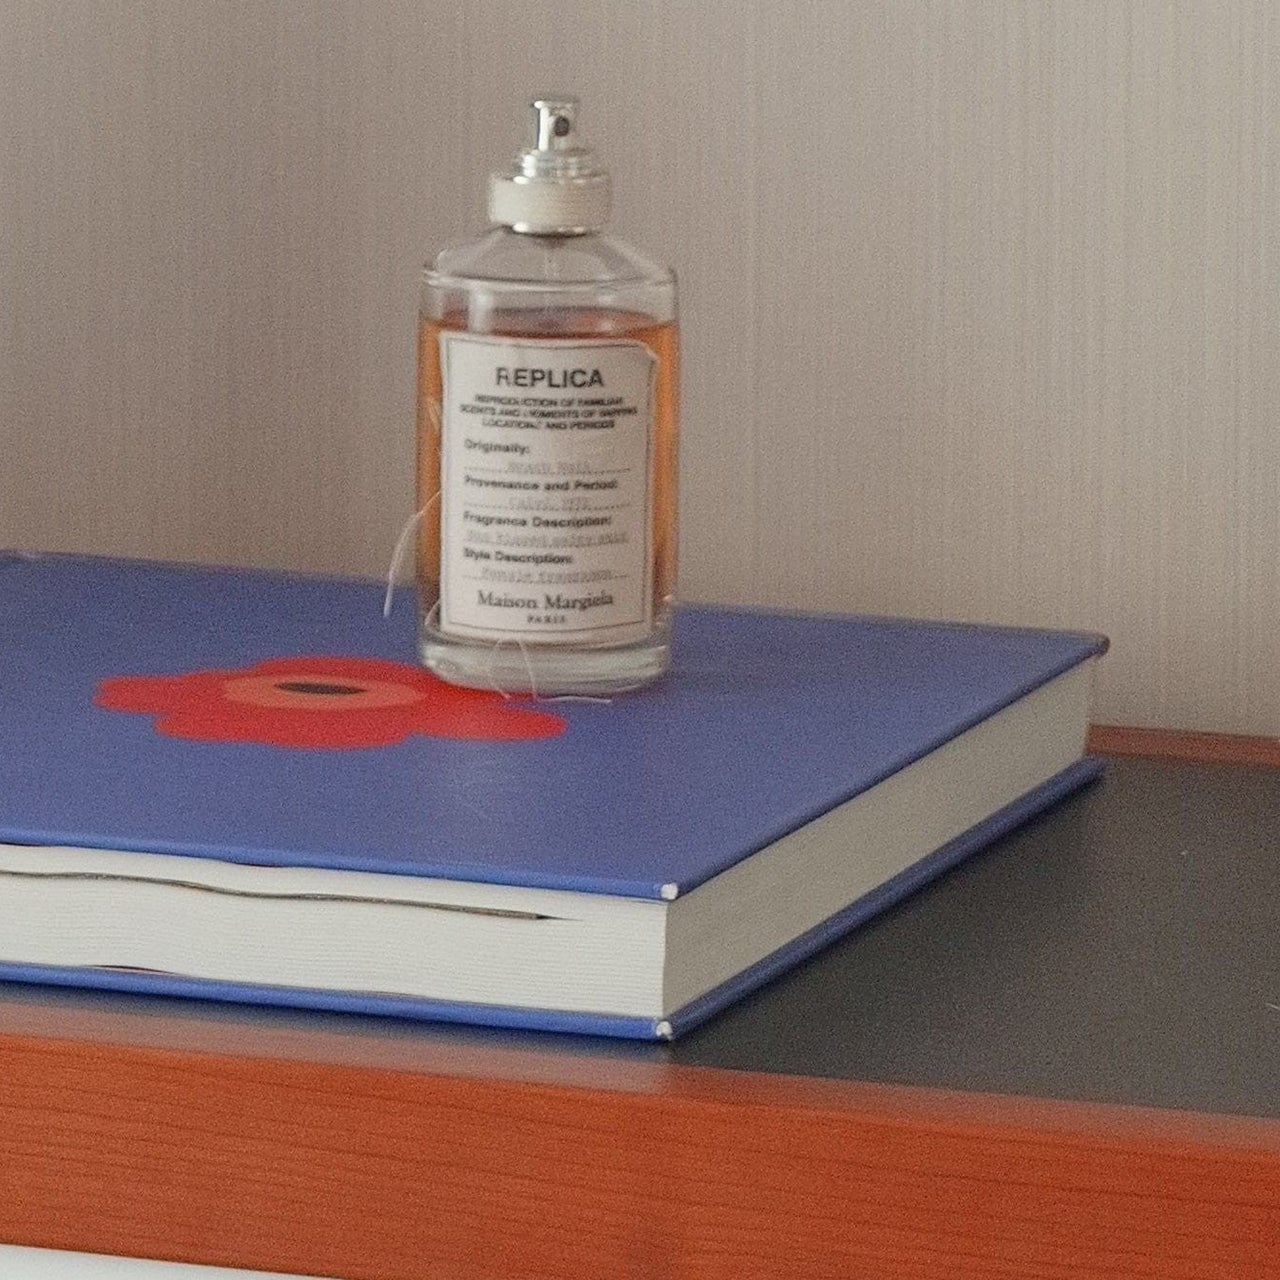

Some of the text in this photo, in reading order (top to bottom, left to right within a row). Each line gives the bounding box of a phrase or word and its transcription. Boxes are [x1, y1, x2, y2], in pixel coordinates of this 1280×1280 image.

[496, 367, 604, 388] REPLICA
[464, 439, 530, 455] Originally:
[464, 475, 540, 491] Provenance
[544, 481, 570, 491] and
[478, 590, 614, 611] Maison Margiela
